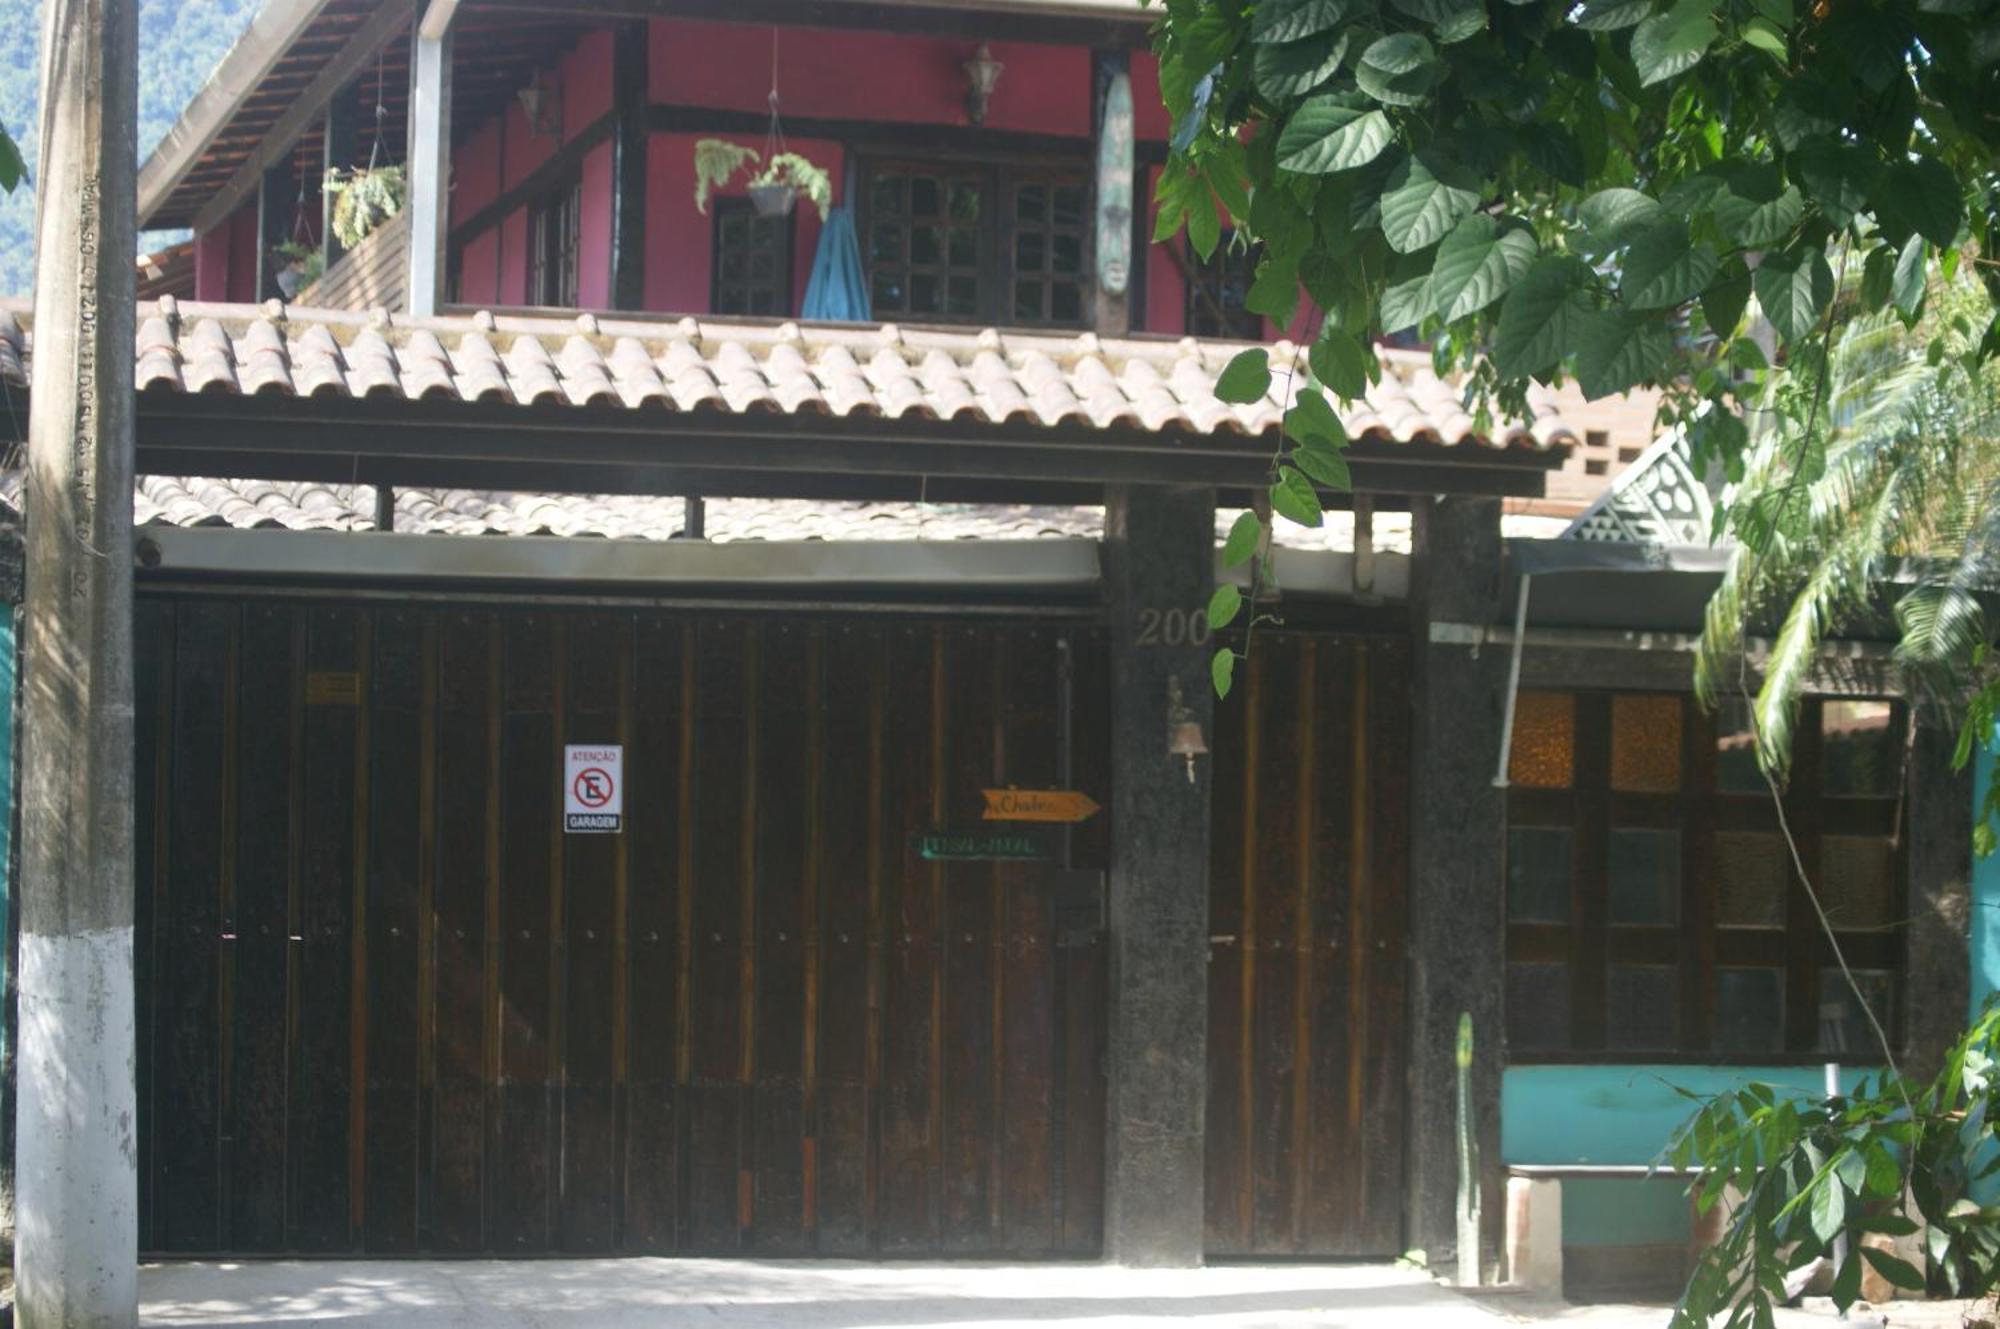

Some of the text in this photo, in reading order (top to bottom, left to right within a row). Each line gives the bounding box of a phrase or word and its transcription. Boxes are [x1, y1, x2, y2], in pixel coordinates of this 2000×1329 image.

[1134, 608, 1211, 647] 200
[572, 750, 616, 762] ATENÇÃO
[569, 816, 617, 828] GARAGEM
